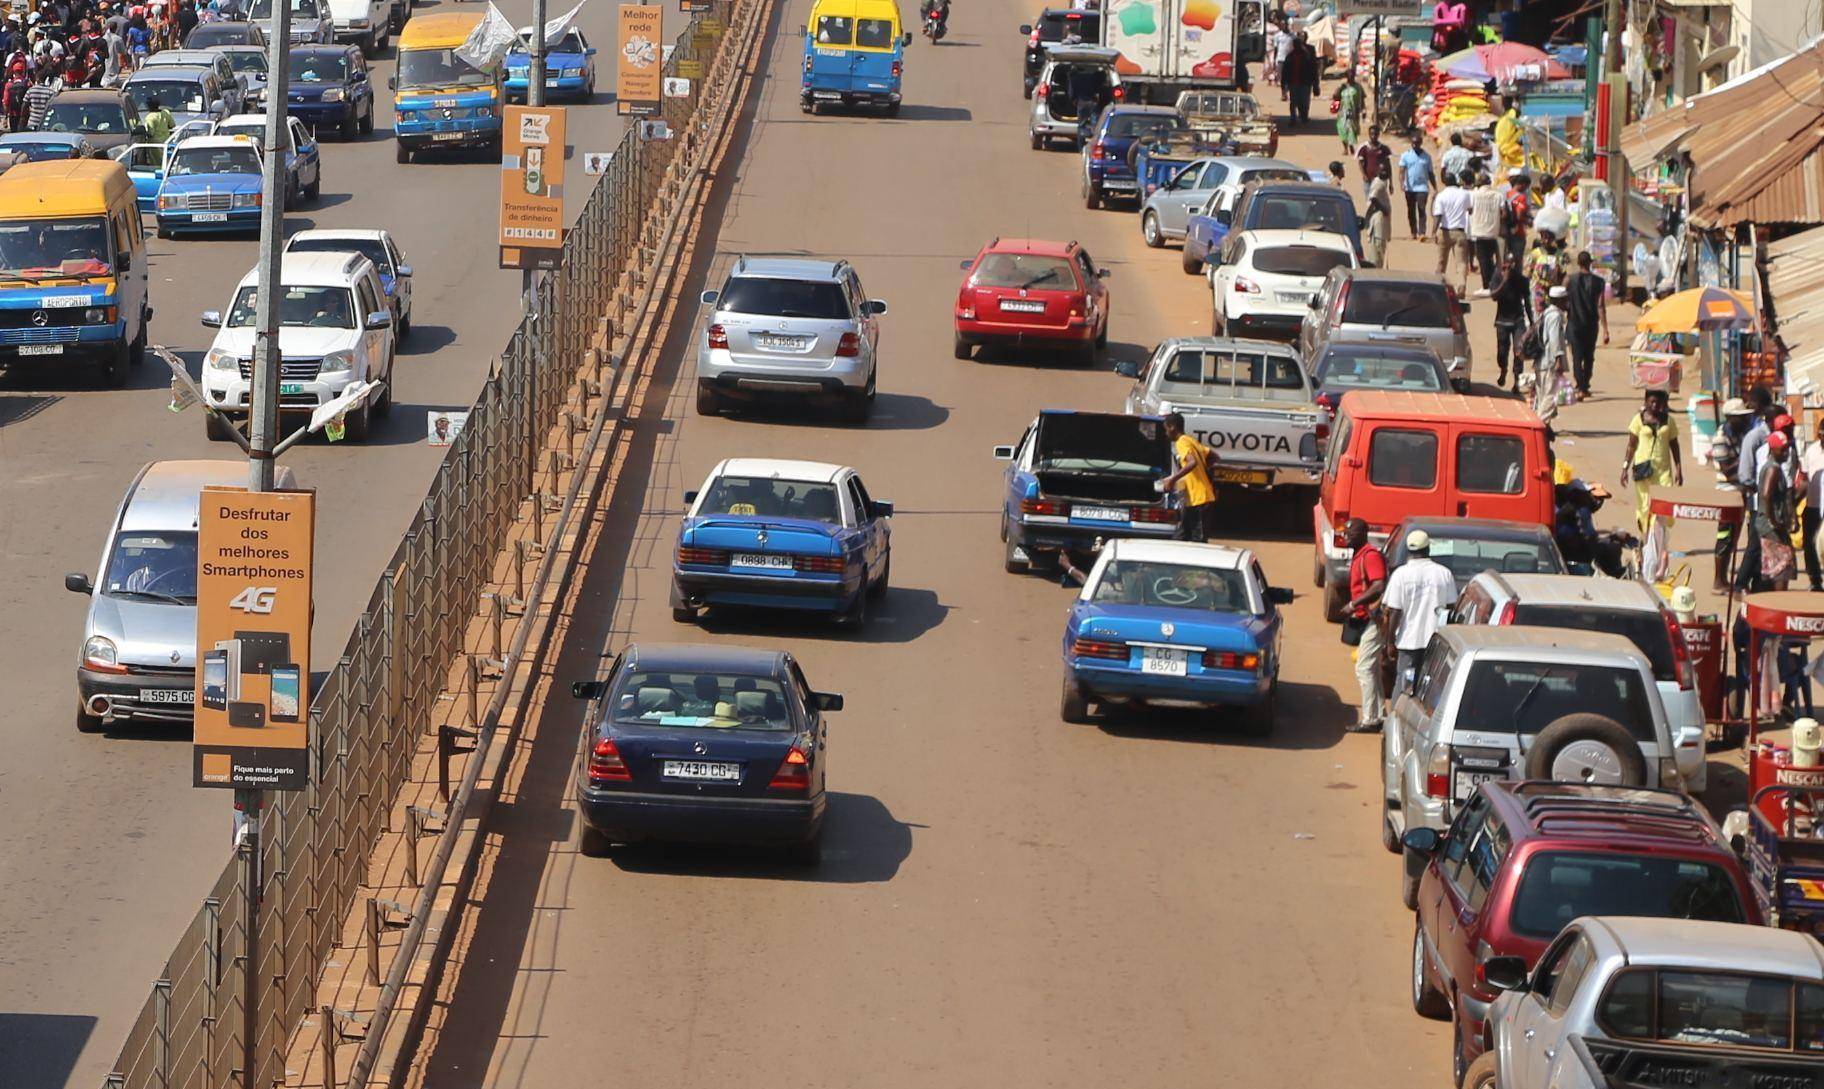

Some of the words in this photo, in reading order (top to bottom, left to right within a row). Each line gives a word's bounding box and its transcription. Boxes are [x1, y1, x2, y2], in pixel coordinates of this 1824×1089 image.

[623, 10, 659, 20] Melhor
[629, 23, 652, 32] rede
[521, 214, 553, 223] dinheiro
[1193, 429, 1291, 453] TOYOTA
[219, 507, 291, 522] Desfrutar
[240, 527, 269, 540] dos
[219, 545, 290, 560] melhores
[202, 563, 305, 580] Smartphones
[229, 586, 277, 615] 4G
[1151, 661, 1178, 672] 8570
[233, 765, 254, 774] Fique
[677, 762, 707, 775] 7430
[711, 764, 726, 777] CG
[233, 774, 244, 782] do
